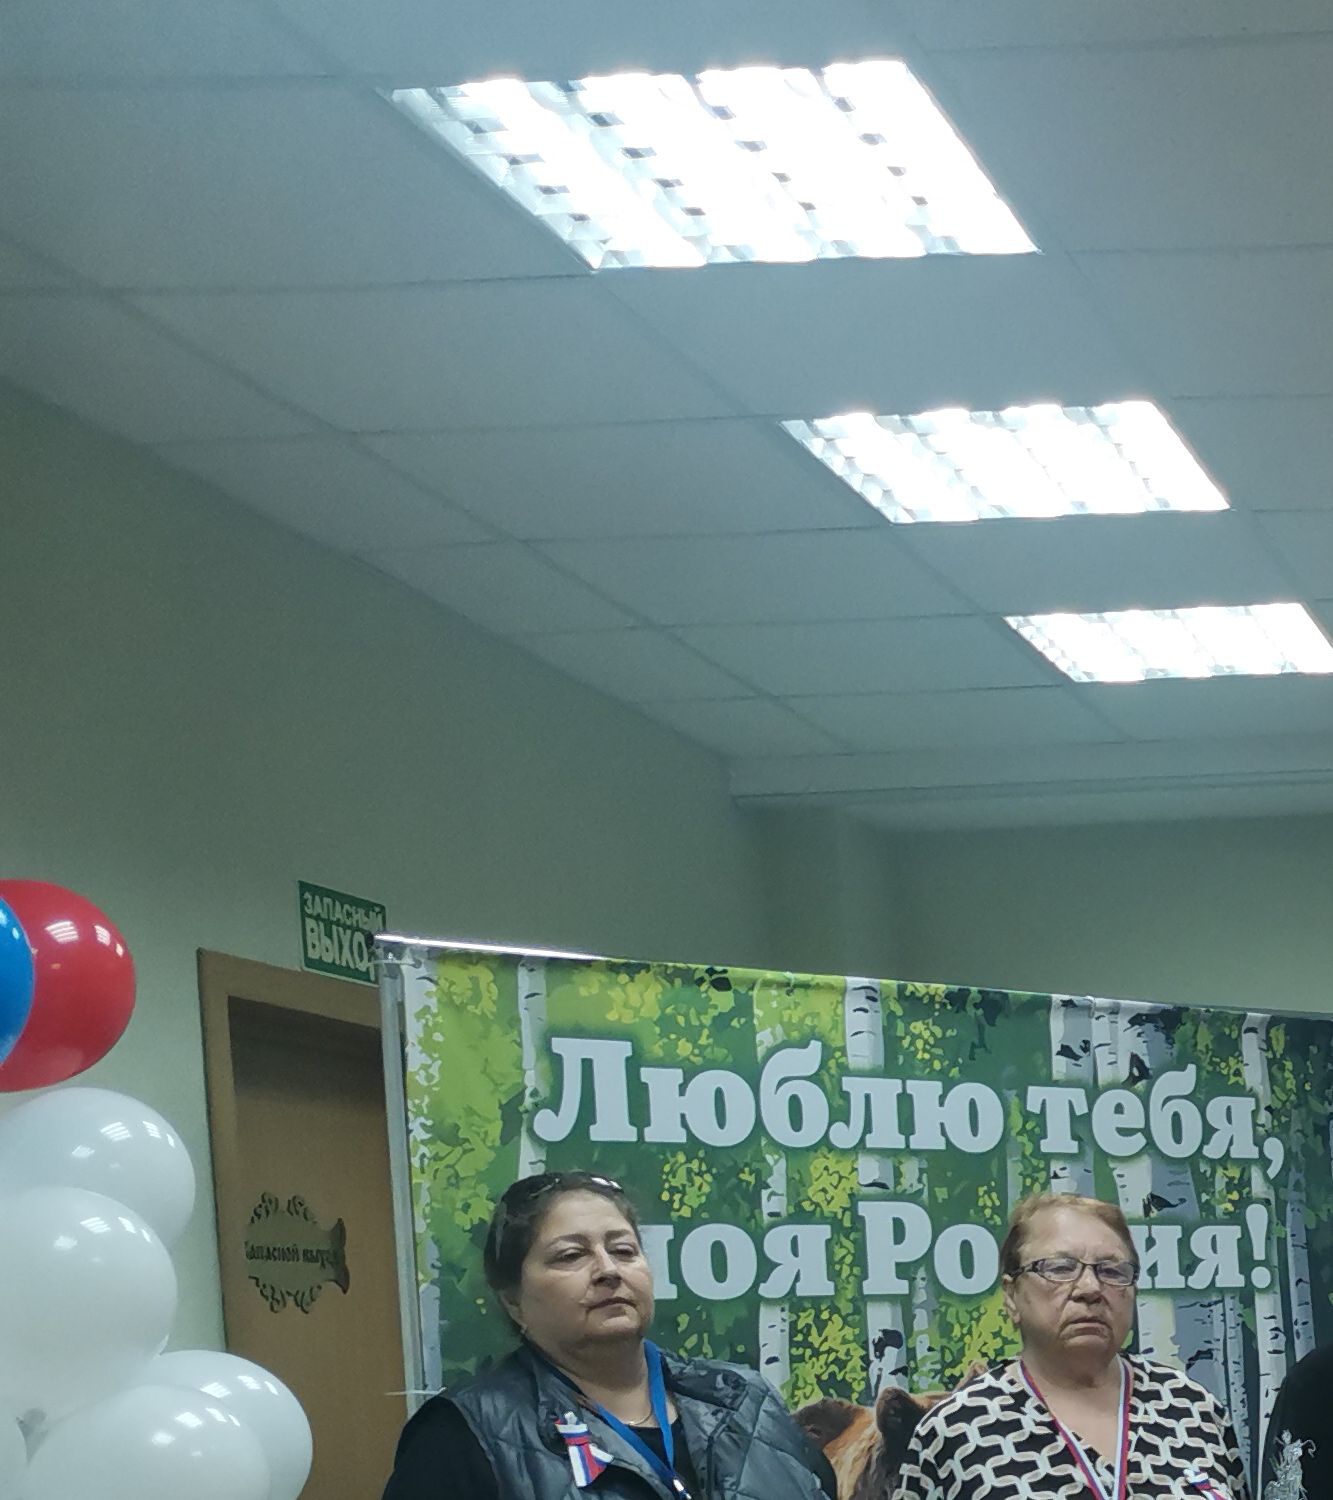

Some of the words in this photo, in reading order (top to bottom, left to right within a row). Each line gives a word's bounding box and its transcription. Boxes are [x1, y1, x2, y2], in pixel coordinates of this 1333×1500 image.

[303, 892, 383, 931] ЗАПАСНЫЙ
[534, 1037, 1002, 1151] Люблю
[1028, 1065, 1285, 1179] тебя,
[858, 1199, 1272, 1297] Роия!
